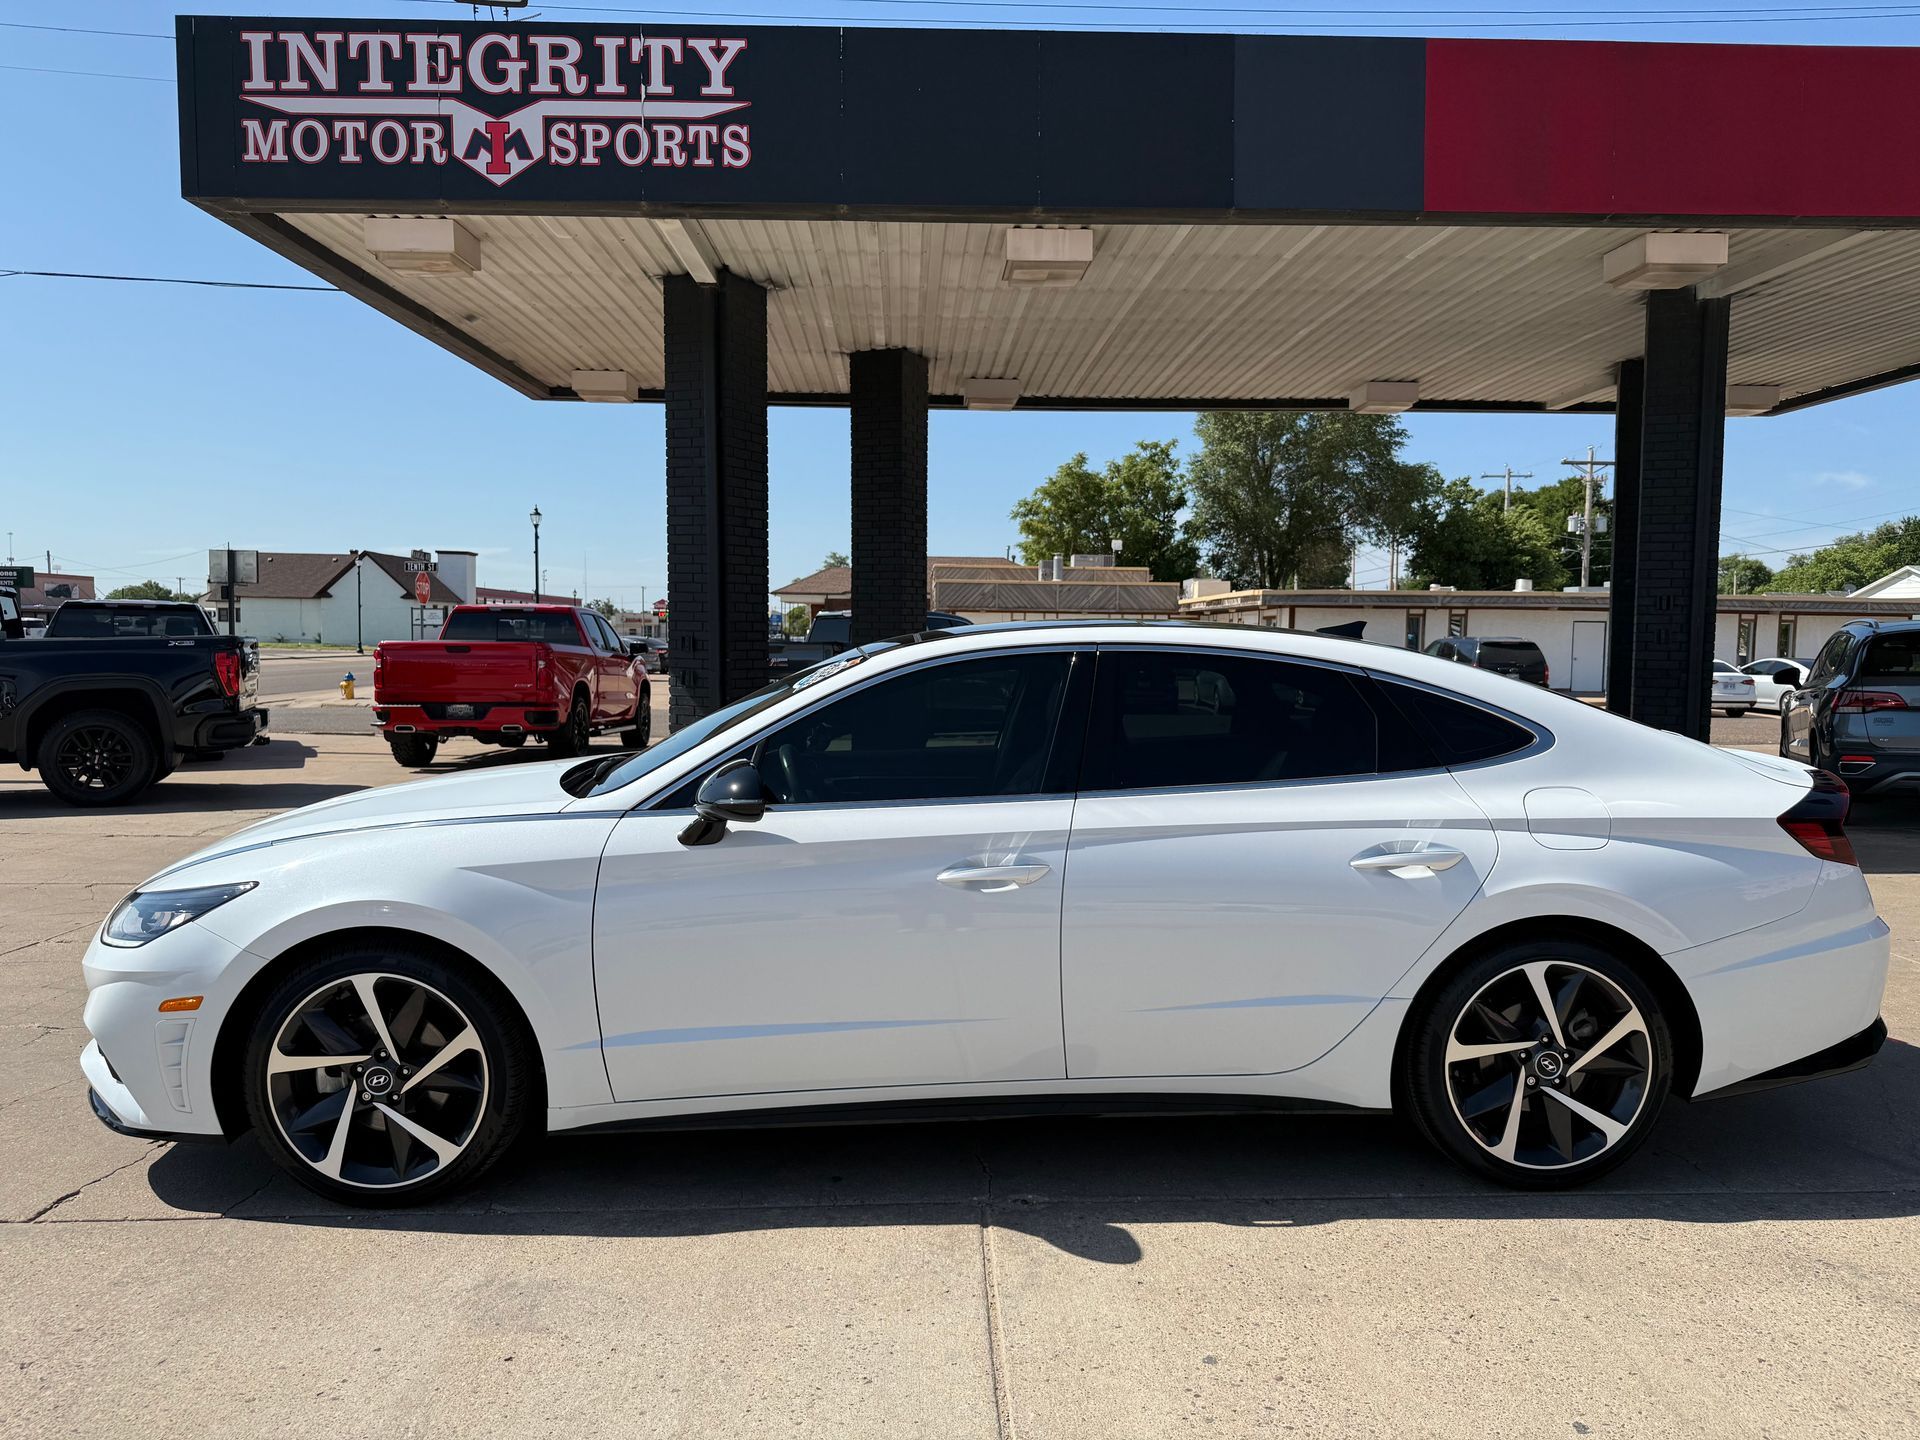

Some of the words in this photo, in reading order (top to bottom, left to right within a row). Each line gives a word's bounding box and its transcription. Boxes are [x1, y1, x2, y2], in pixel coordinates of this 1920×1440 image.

[240, 31, 748, 96] INTEGRITY
[241, 118, 449, 165] MOTOR
[548, 121, 751, 168] SPORTS
[407, 562, 425, 571] TENTH
[428, 563, 435, 571] ST
[416, 582, 430, 595] STOP
